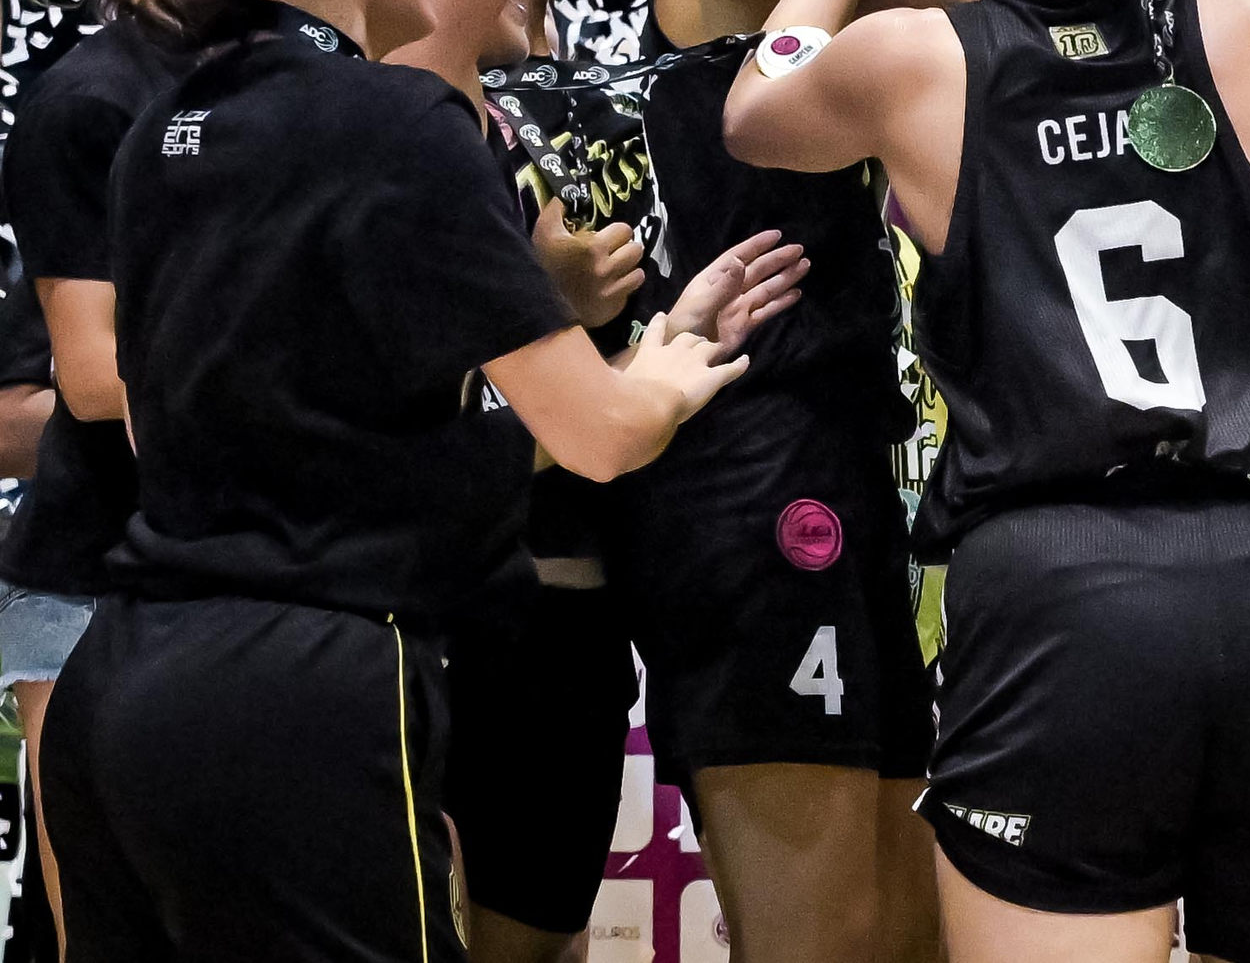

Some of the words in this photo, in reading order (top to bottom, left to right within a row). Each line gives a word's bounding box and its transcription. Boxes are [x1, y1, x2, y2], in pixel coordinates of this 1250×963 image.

[299, 24, 327, 43] ADC
[521, 71, 547, 82] ADC
[572, 71, 598, 81] ADC
[1054, 200, 1207, 413] 6
[789, 626, 844, 715] 4
